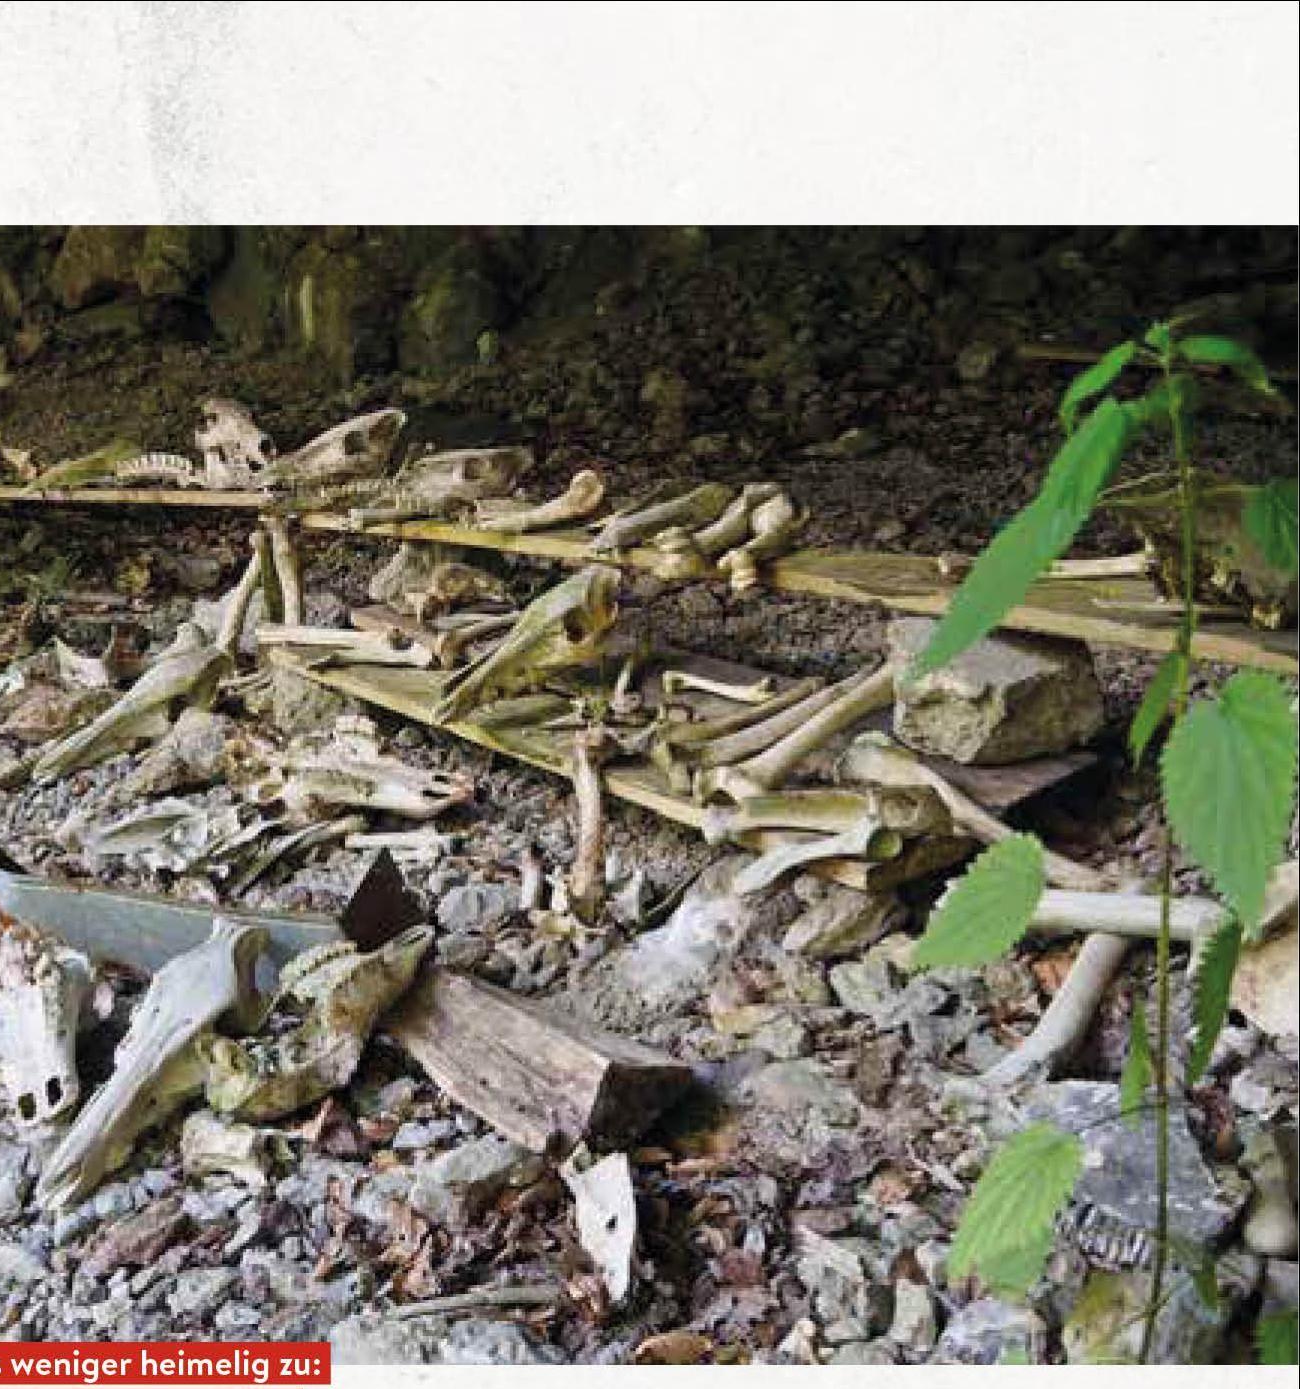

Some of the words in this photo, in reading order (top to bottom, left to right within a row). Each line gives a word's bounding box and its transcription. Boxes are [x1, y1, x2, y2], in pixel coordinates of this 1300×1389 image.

[11, 1350, 131, 1383] weniger
[142, 1350, 268, 1383] heimelig
[281, 1359, 320, 1375] zu:
